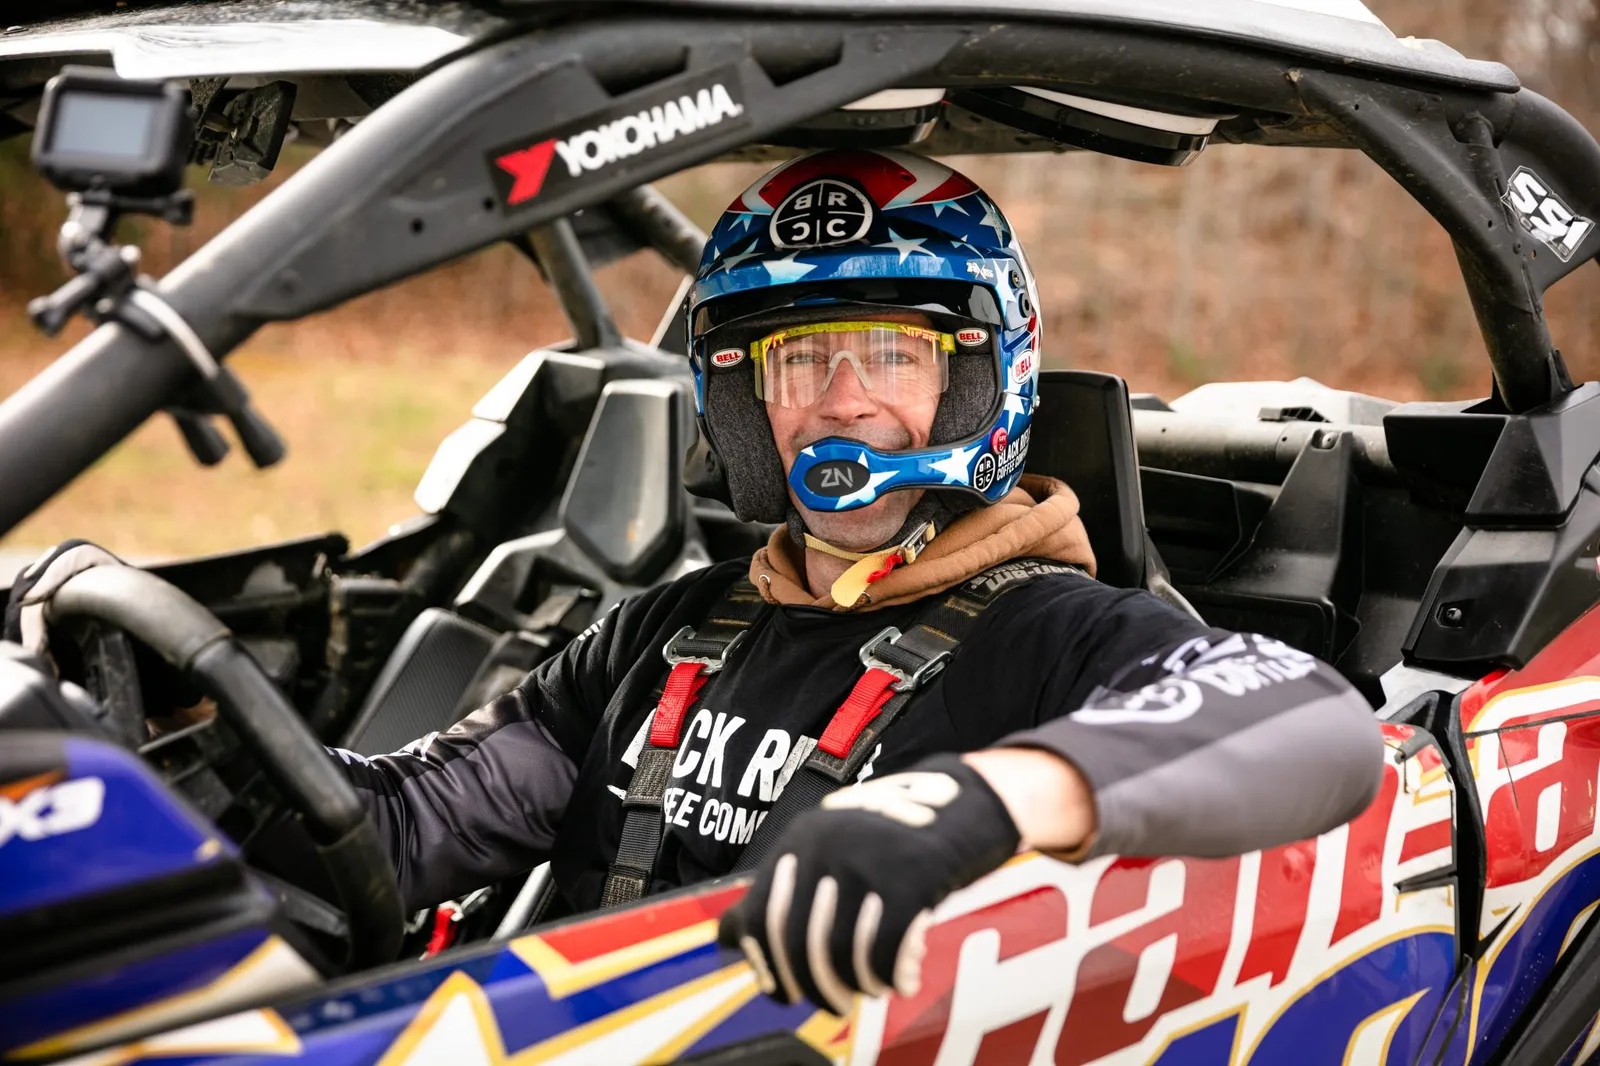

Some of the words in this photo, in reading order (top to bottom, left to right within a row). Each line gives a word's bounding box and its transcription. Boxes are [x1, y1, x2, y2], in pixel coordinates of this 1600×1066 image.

[555, 84, 742, 177] YOKOHAMA
[959, 332, 983, 341] BELL
[716, 352, 741, 363] BELL
[1015, 355, 1032, 377] BELL
[998, 437, 1020, 468] BLACK
[997, 458, 1015, 481] COFFEE
